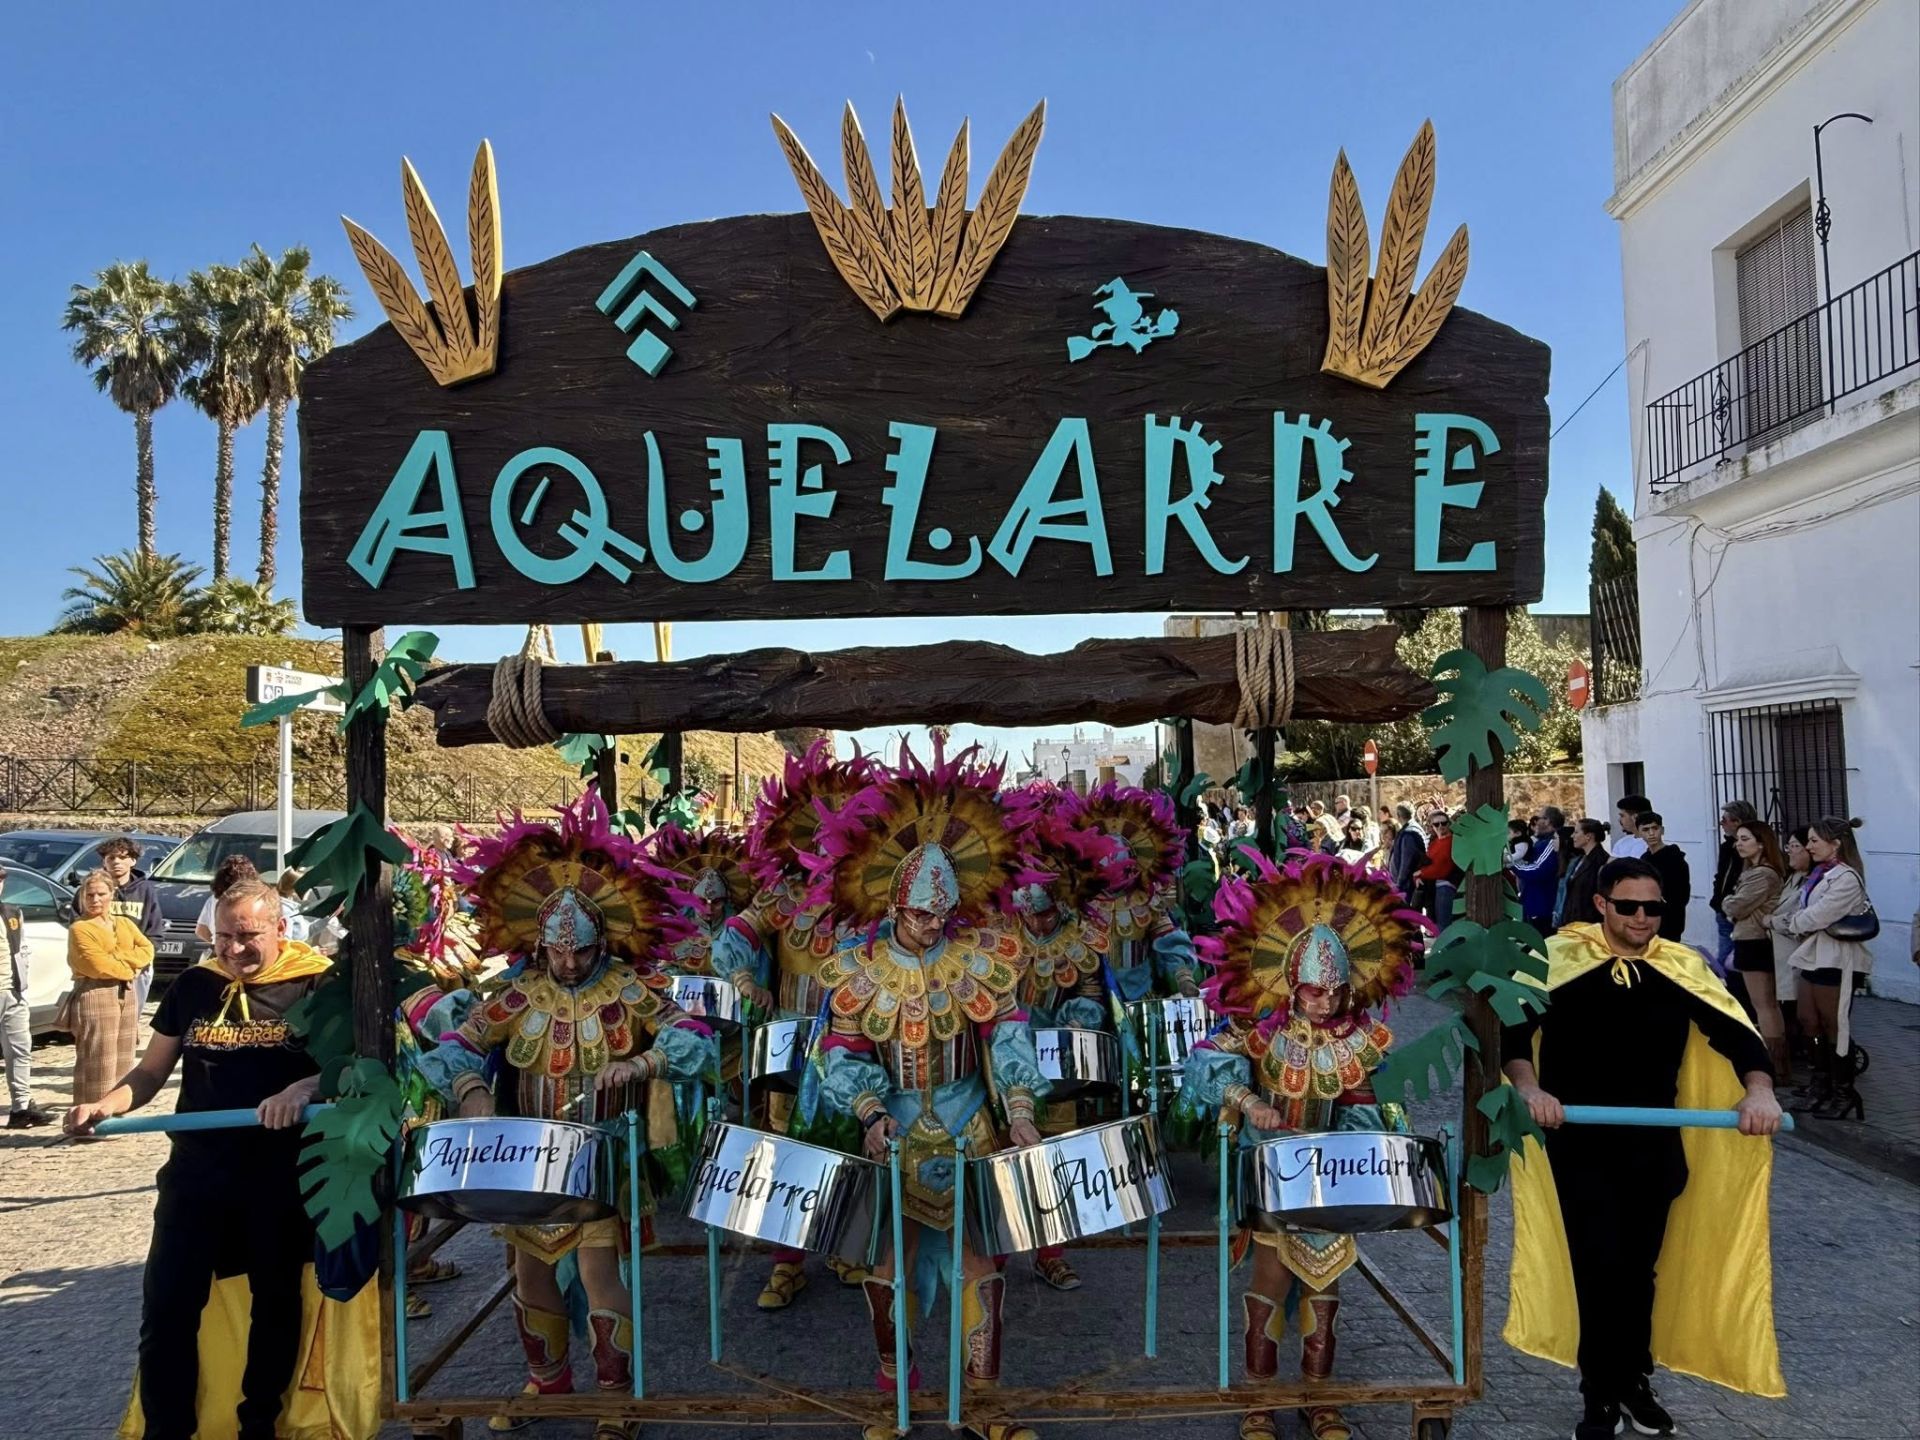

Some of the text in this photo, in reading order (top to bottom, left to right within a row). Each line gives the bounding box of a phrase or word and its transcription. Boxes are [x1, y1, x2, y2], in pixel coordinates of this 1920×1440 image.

[347, 411, 1501, 591] AQUELARRE
[419, 1134, 560, 1177] Aquelarre
[1278, 1147, 1425, 1188] Aquelarre
